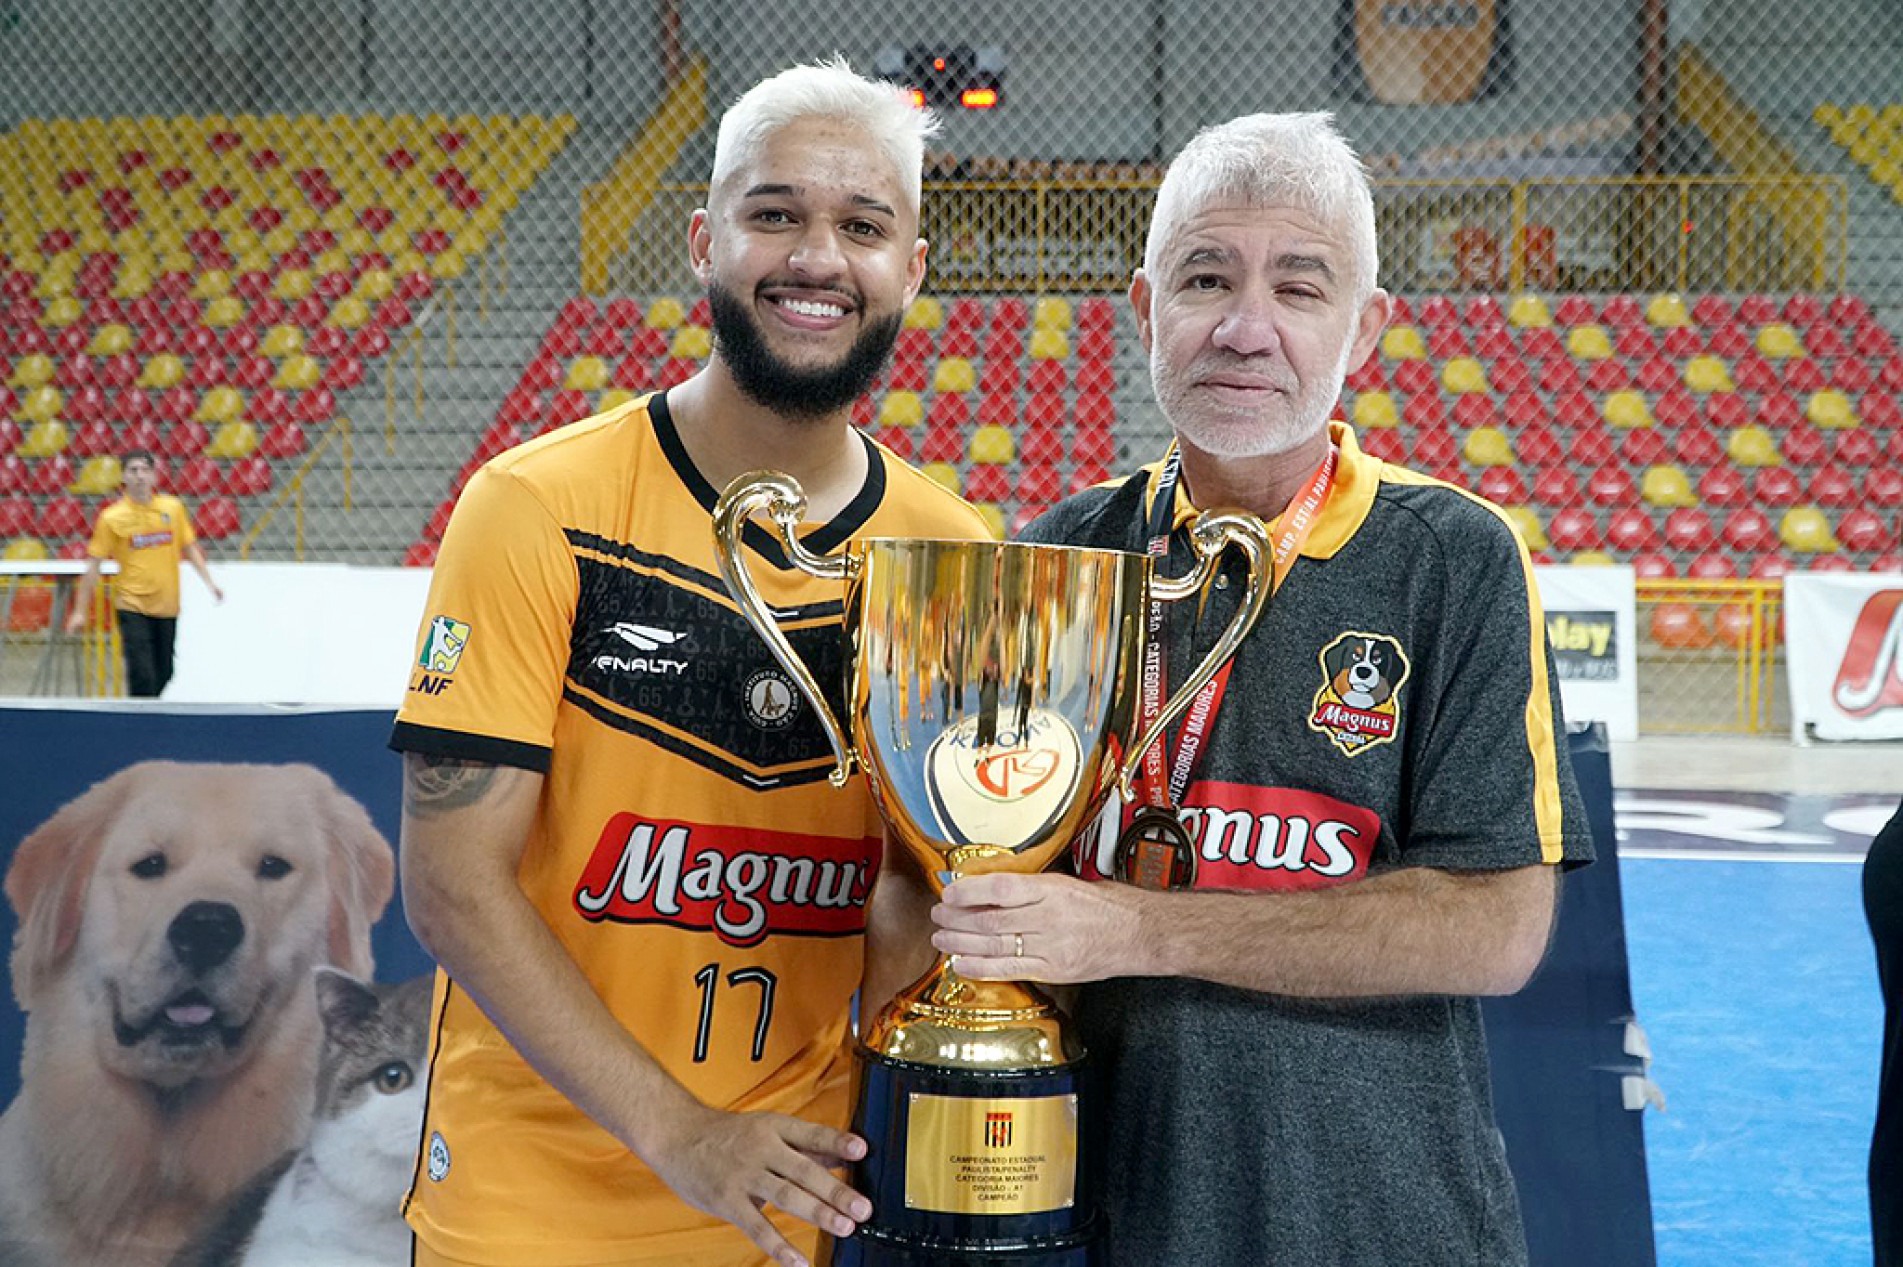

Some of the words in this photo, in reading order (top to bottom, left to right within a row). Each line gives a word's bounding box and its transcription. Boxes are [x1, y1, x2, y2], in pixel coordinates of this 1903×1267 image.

[1547, 614, 1612, 657] lay
[1144, 642, 1161, 718] CATEGORIAS
[1313, 704, 1391, 733] Magnus
[1169, 733, 1200, 806] ATEGORIAS
[1186, 679, 1218, 737] MAIORES
[692, 963, 778, 1064] 17
[949, 1155, 1007, 1164] CAMPEONATO
[1008, 1155, 1046, 1163] ESTADUAL
[955, 1174, 1003, 1182] CATEGORIA
[1004, 1174, 1039, 1182] MAIORES
